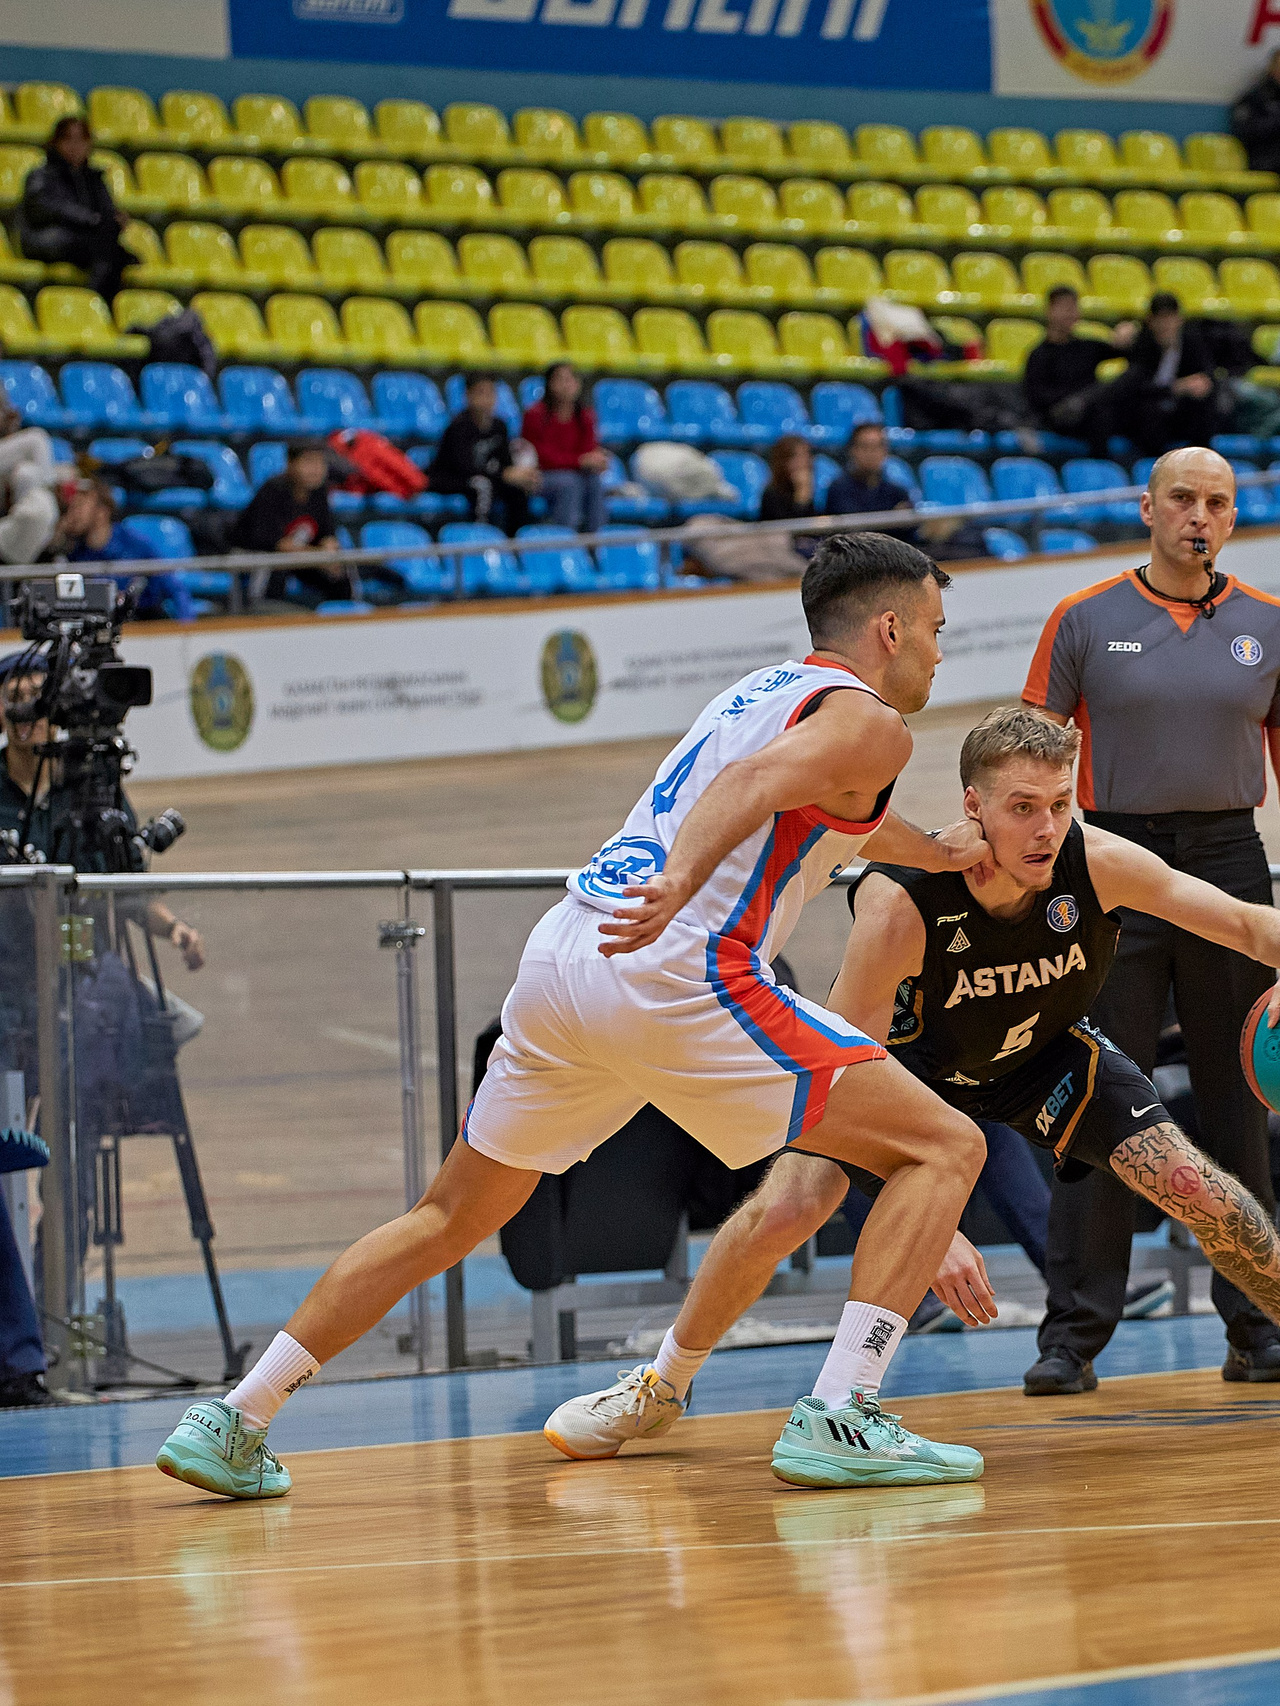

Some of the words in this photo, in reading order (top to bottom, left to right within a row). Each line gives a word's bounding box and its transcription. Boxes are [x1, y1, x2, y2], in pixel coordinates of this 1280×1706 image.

[944, 943, 1087, 1009] ASTANA
[989, 1011, 1041, 1062] 5
[1035, 1071, 1074, 1137] 1XBET
